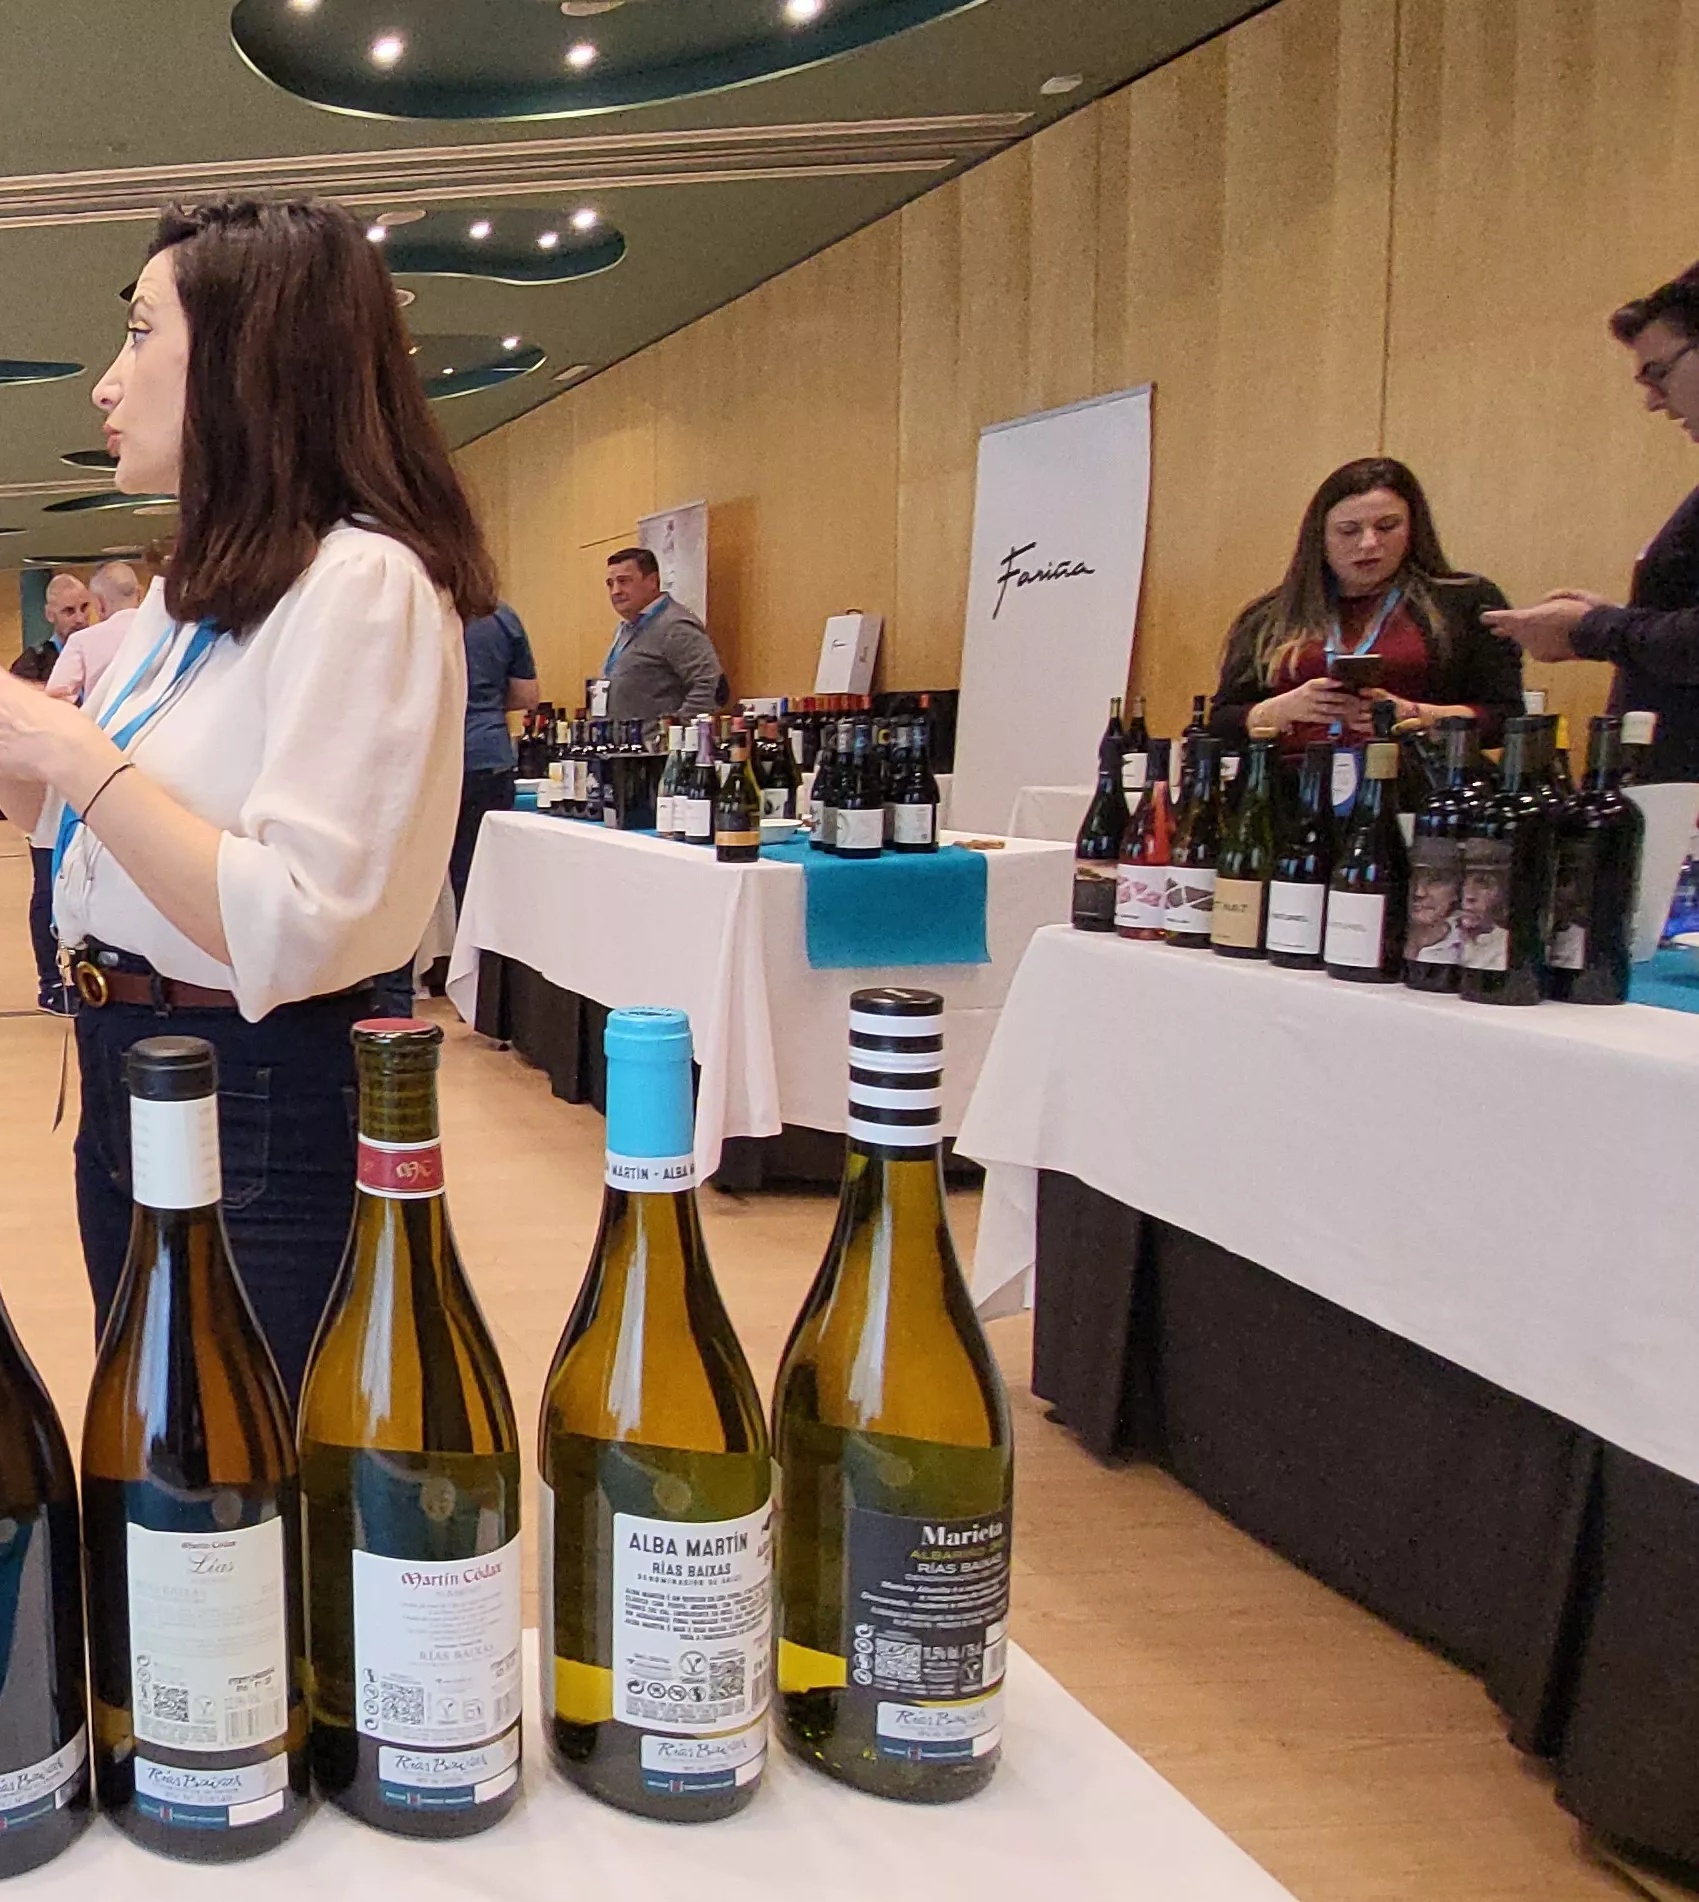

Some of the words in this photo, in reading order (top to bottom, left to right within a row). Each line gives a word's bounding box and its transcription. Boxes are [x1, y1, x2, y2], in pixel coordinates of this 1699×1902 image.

[992, 541, 1095, 620] Fariña
[629, 1532, 678, 1556] ALBA
[686, 1531, 749, 1557] MARTÍN
[921, 1521, 1004, 1547] Marieta
[401, 1572, 459, 1591] Martín
[652, 1560, 683, 1577] RÍAS
[687, 1562, 732, 1578] BAIXAS
